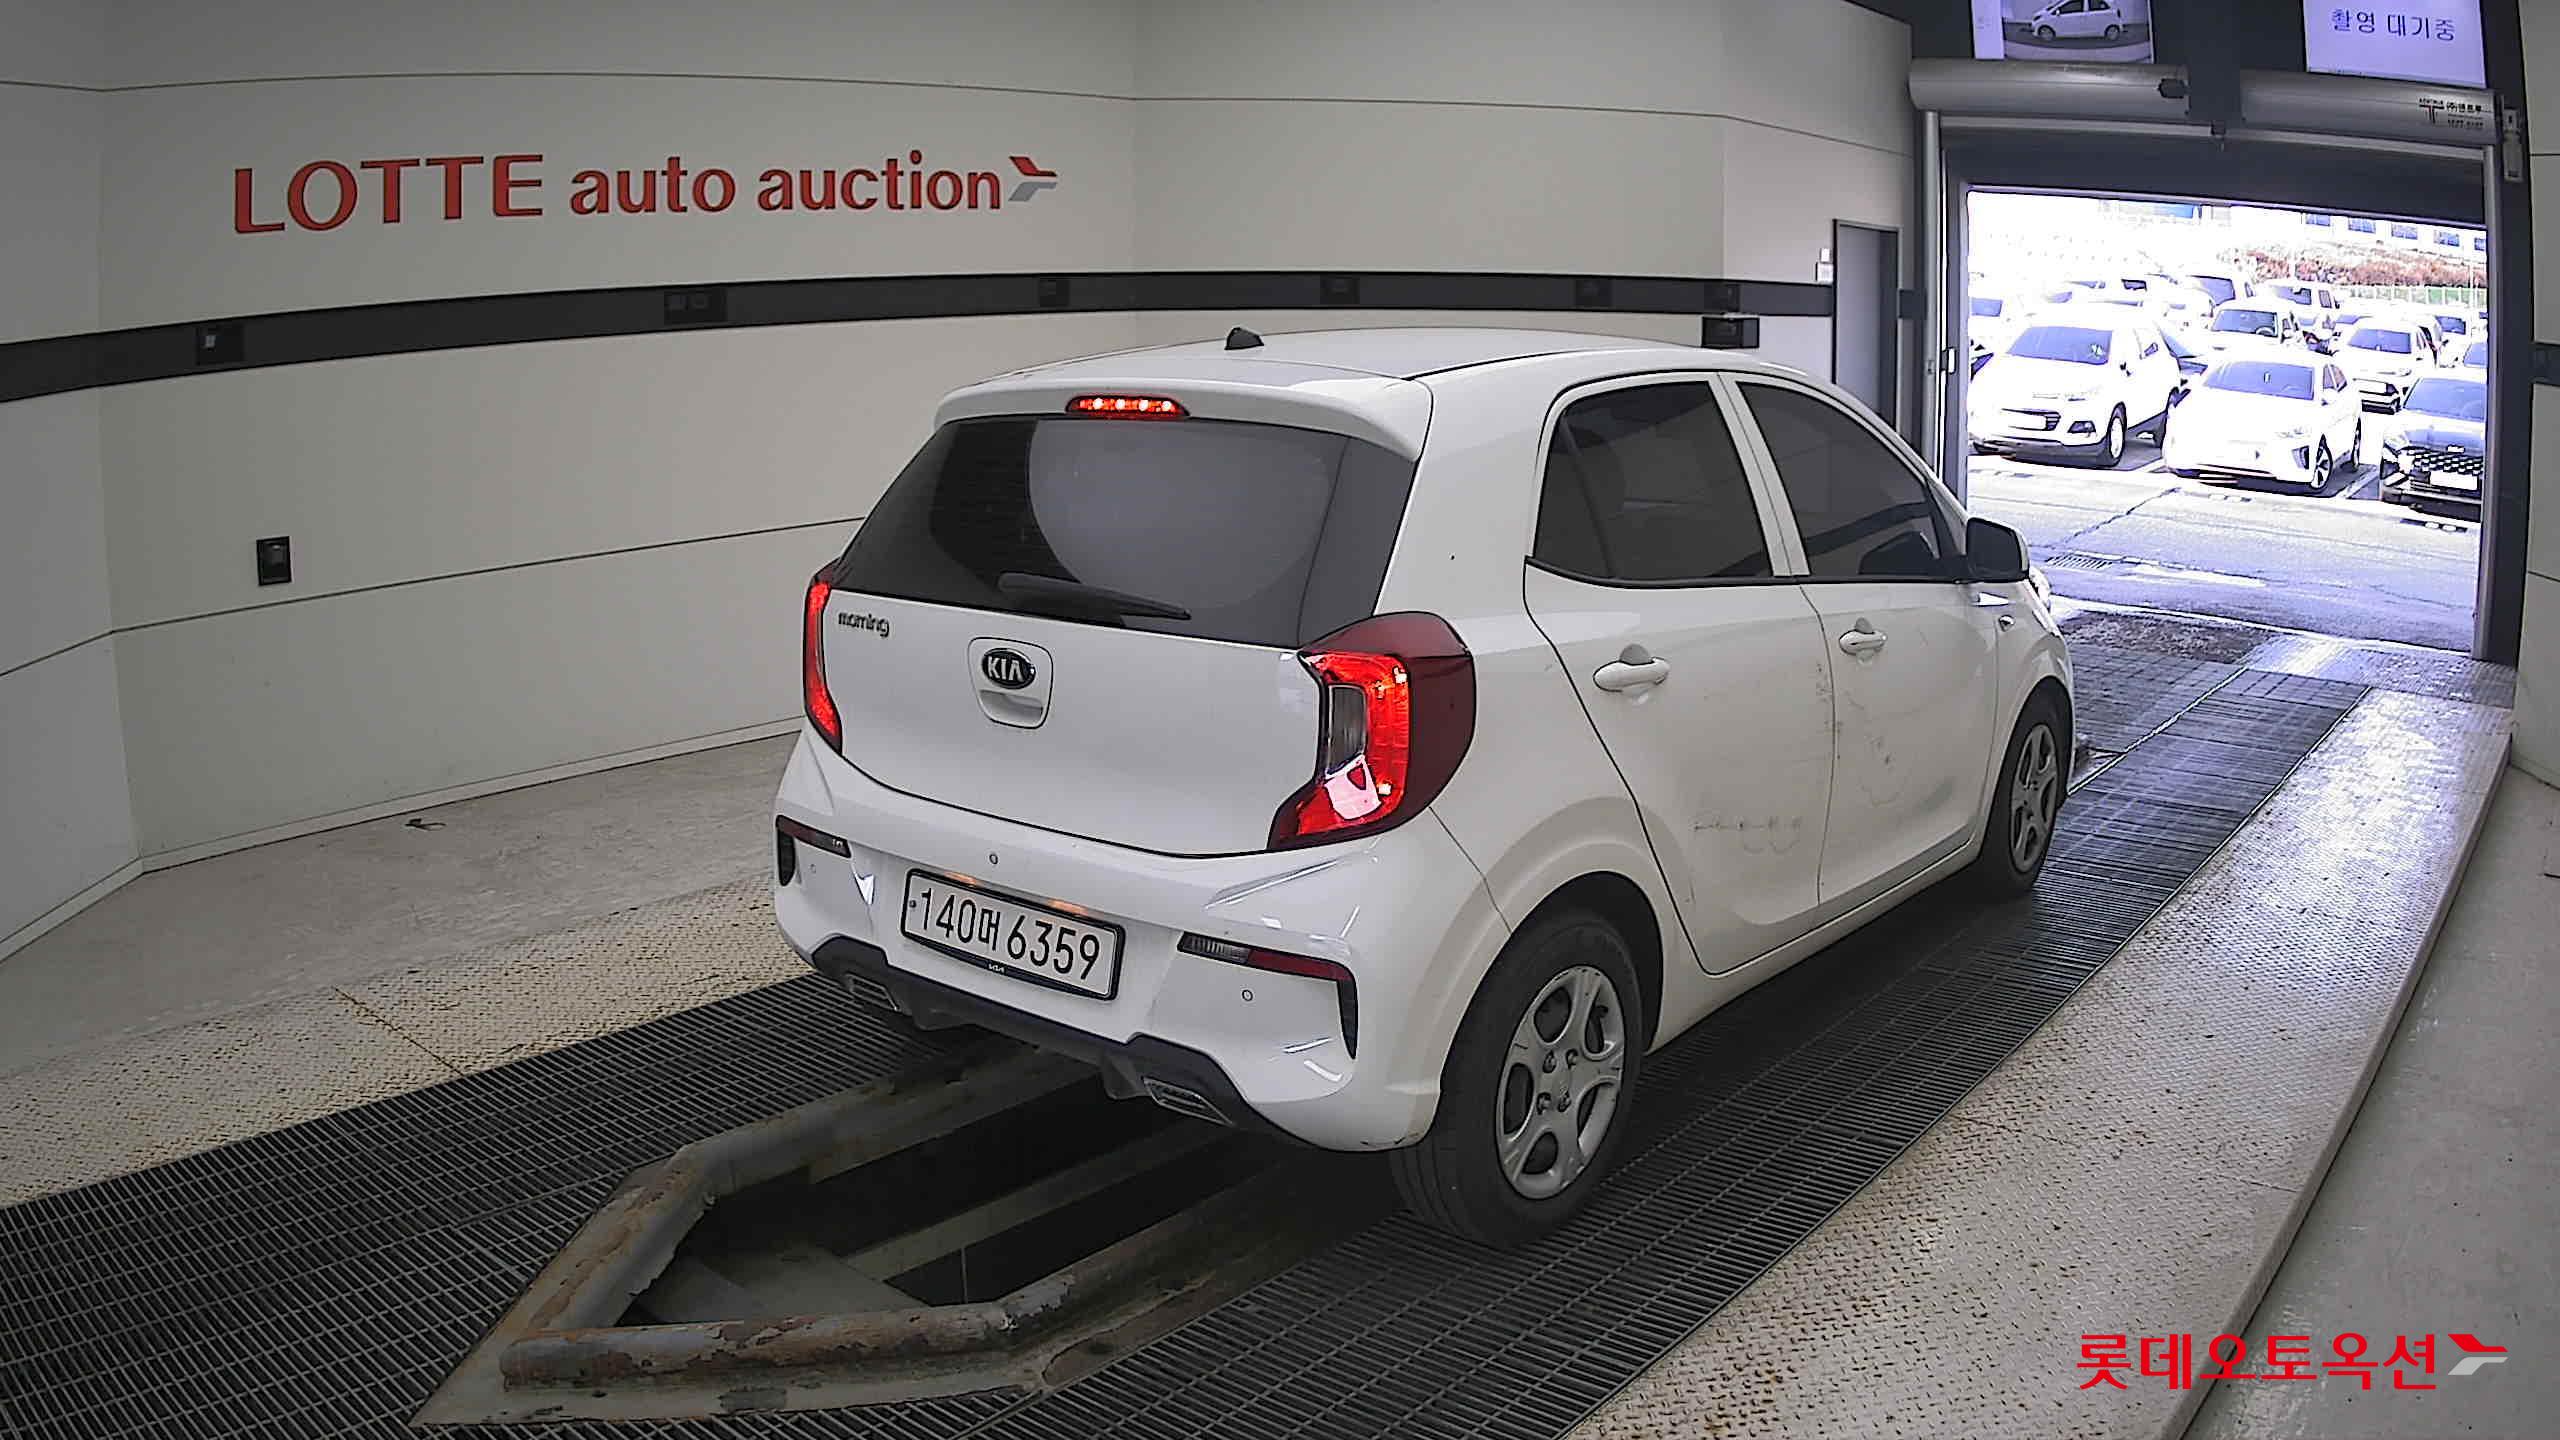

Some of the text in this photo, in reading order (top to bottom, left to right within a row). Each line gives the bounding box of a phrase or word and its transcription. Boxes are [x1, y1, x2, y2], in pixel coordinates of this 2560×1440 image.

[2331, 9, 2456, 41] 촬영 대기중
[234, 149, 1002, 234] LOTTE auto auction
[838, 612, 890, 638] morning
[987, 655, 1025, 682] KIA
[921, 887, 1101, 981] 140머 6359
